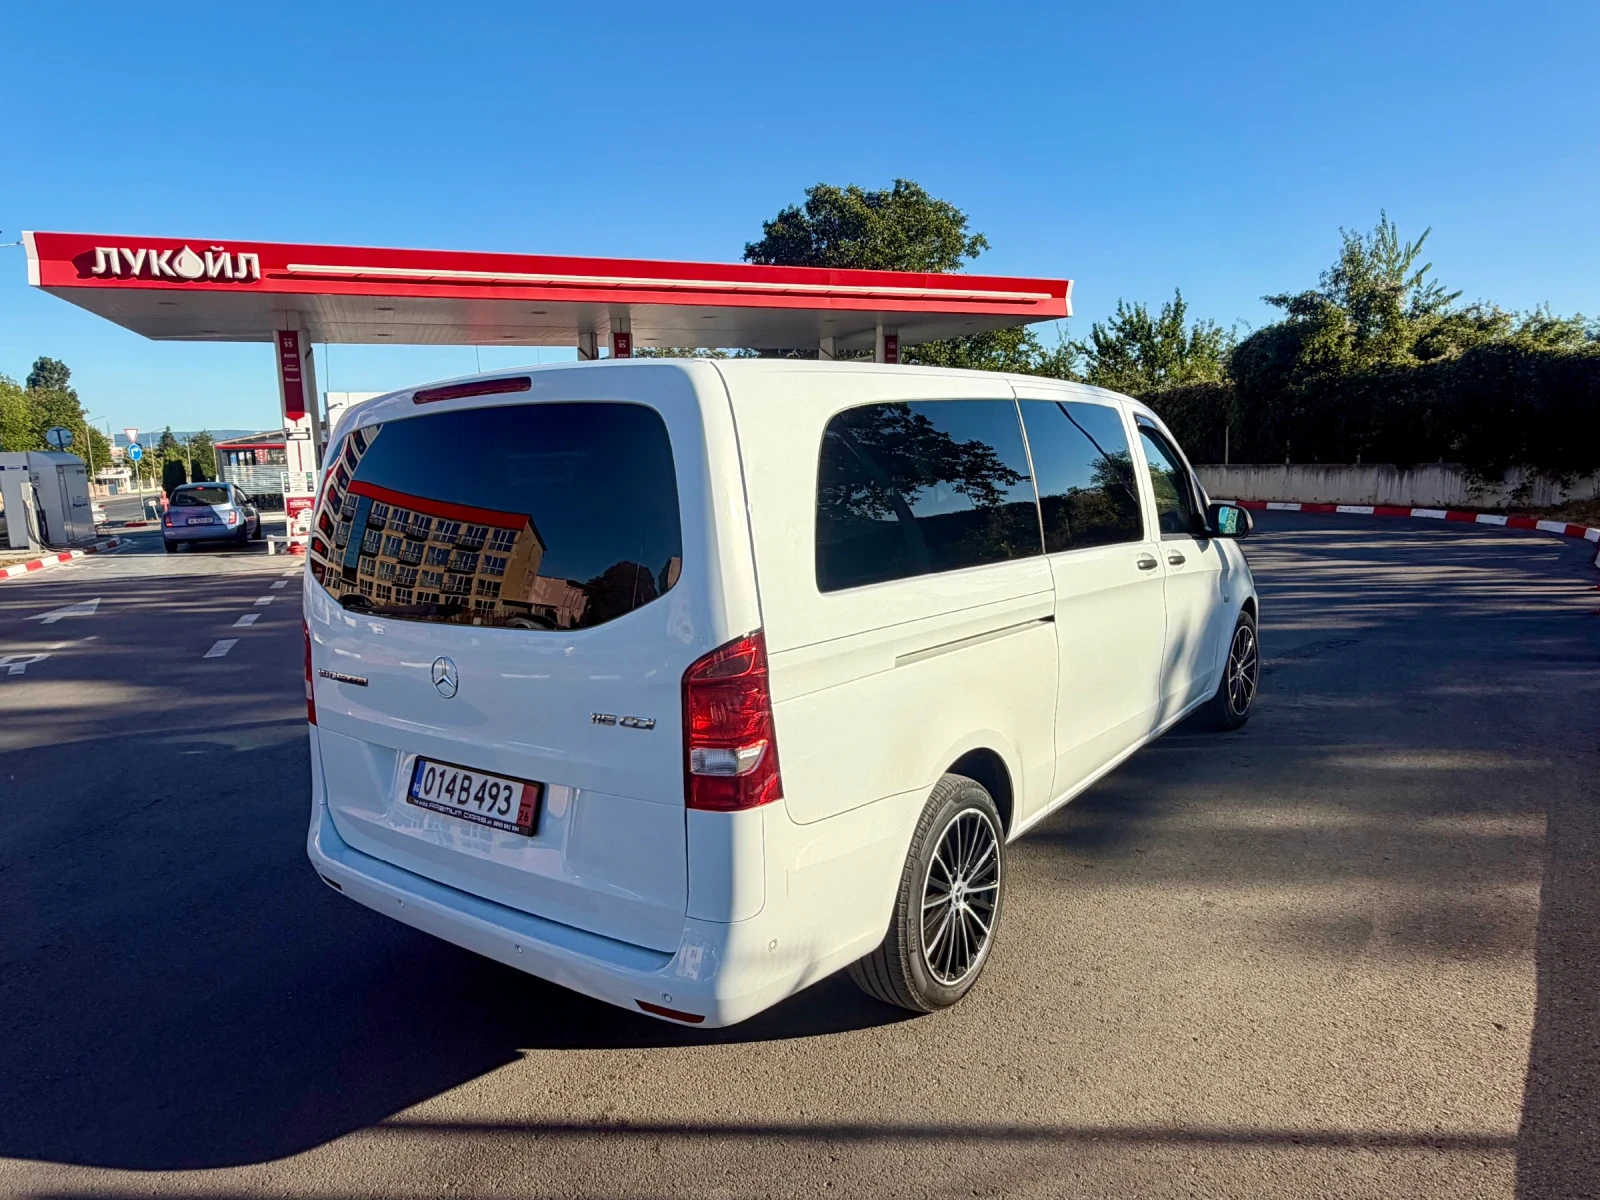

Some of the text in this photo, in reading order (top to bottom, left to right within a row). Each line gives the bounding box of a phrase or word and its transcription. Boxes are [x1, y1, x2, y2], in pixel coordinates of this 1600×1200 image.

[91, 245, 261, 280] ЛУКОЙЛ
[423, 766, 513, 816] 014B493
[463, 811, 487, 824] CARS
[518, 810, 529, 823] 26
